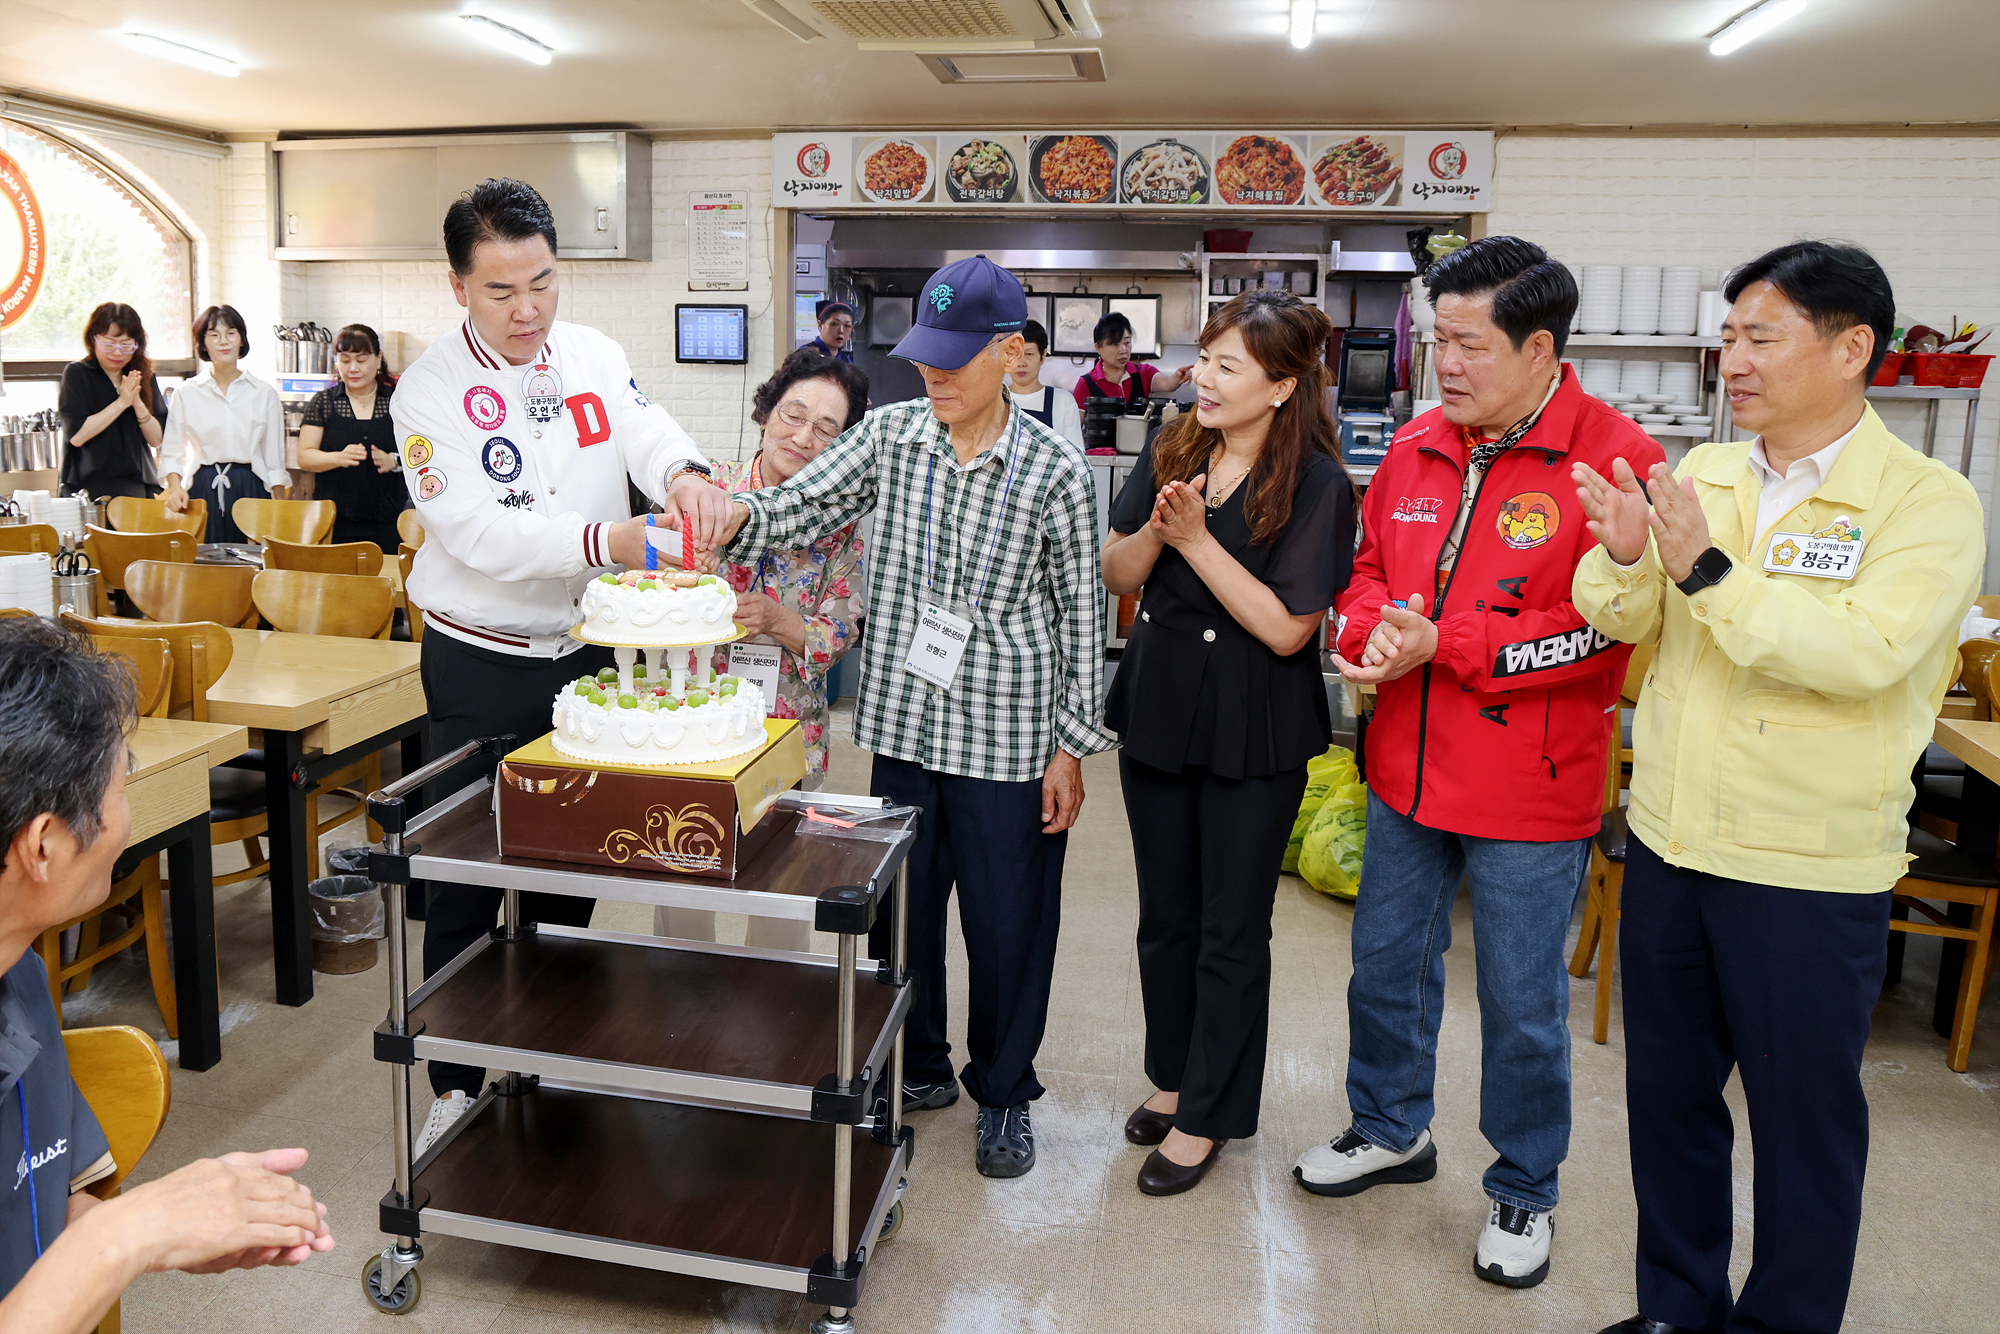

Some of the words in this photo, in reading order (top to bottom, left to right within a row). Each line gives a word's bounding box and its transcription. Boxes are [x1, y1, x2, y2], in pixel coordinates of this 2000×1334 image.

[784, 180, 843, 197] 낙지애가
[876, 188, 911, 199] 낙지덮밥
[959, 188, 1005, 199] 전복갈비탕
[1054, 189, 1091, 199] 낙지볶음
[1412, 182, 1480, 201] 낙지애가
[1142, 189, 1190, 200] 낙지갈비찜
[1236, 190, 1284, 201] 낙지해물찜
[1336, 191, 1375, 202] 호롱구이
[564, 391, 612, 449] D
[488, 438, 505, 448] SEOUL
[488, 469, 512, 482] DOBONG
[510, 463, 521, 480] SOCKS
[1807, 541, 1839, 551] 도봉구의회
[1840, 544, 1854, 552] 의원
[1801, 551, 1850, 571] 정승구
[1505, 625, 1594, 674] ARENA
